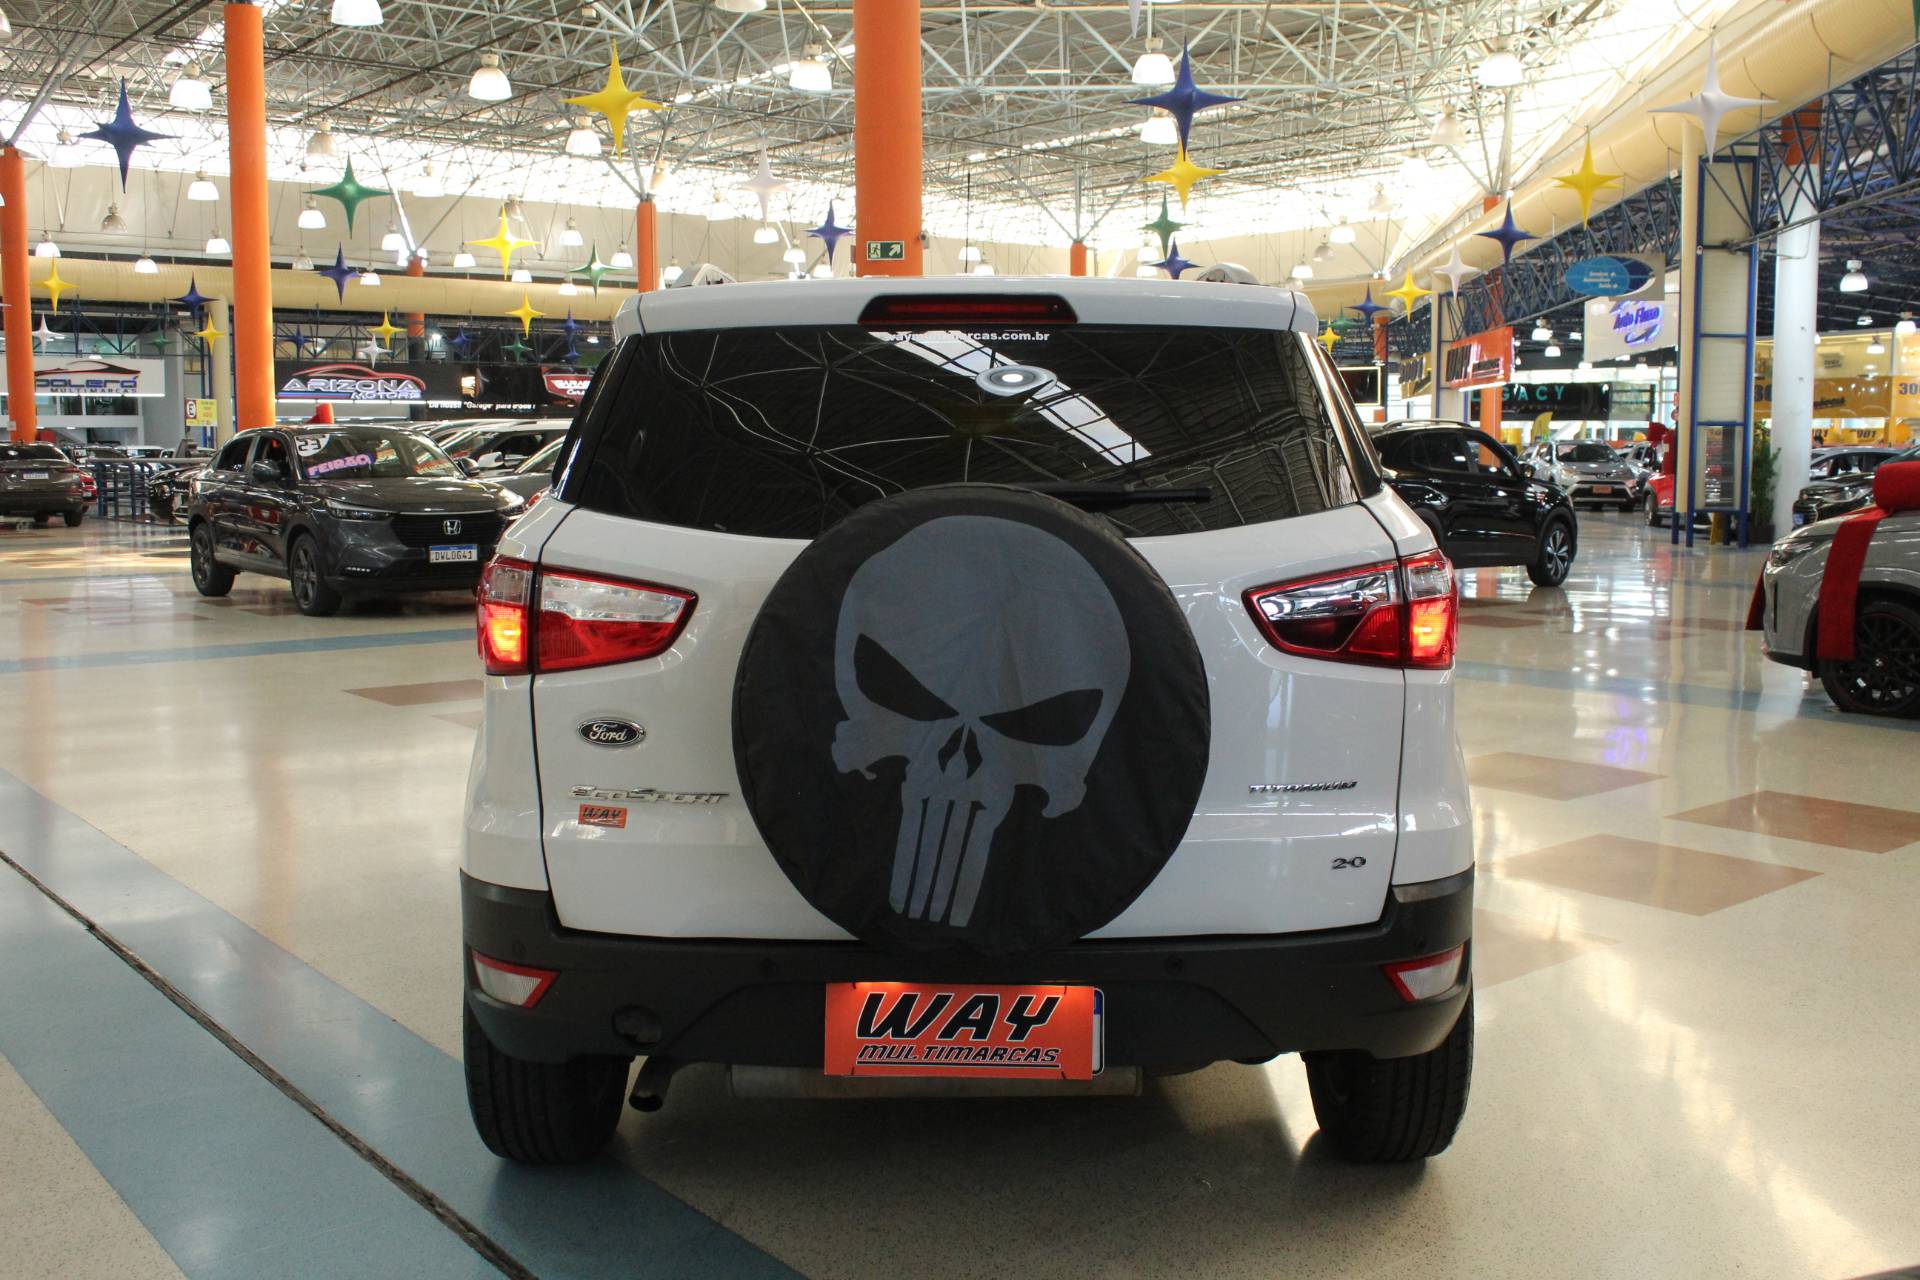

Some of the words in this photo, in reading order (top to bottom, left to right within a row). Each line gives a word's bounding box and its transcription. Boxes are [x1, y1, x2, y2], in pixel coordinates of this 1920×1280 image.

[282, 378, 422, 393] ARIZONA
[351, 391, 421, 400] MOTORS
[589, 722, 627, 742] Ford
[1248, 781, 1358, 794] TITANIUM
[856, 991, 1062, 1042] WAY
[857, 1044, 1062, 1063] MULTIMARCAS
